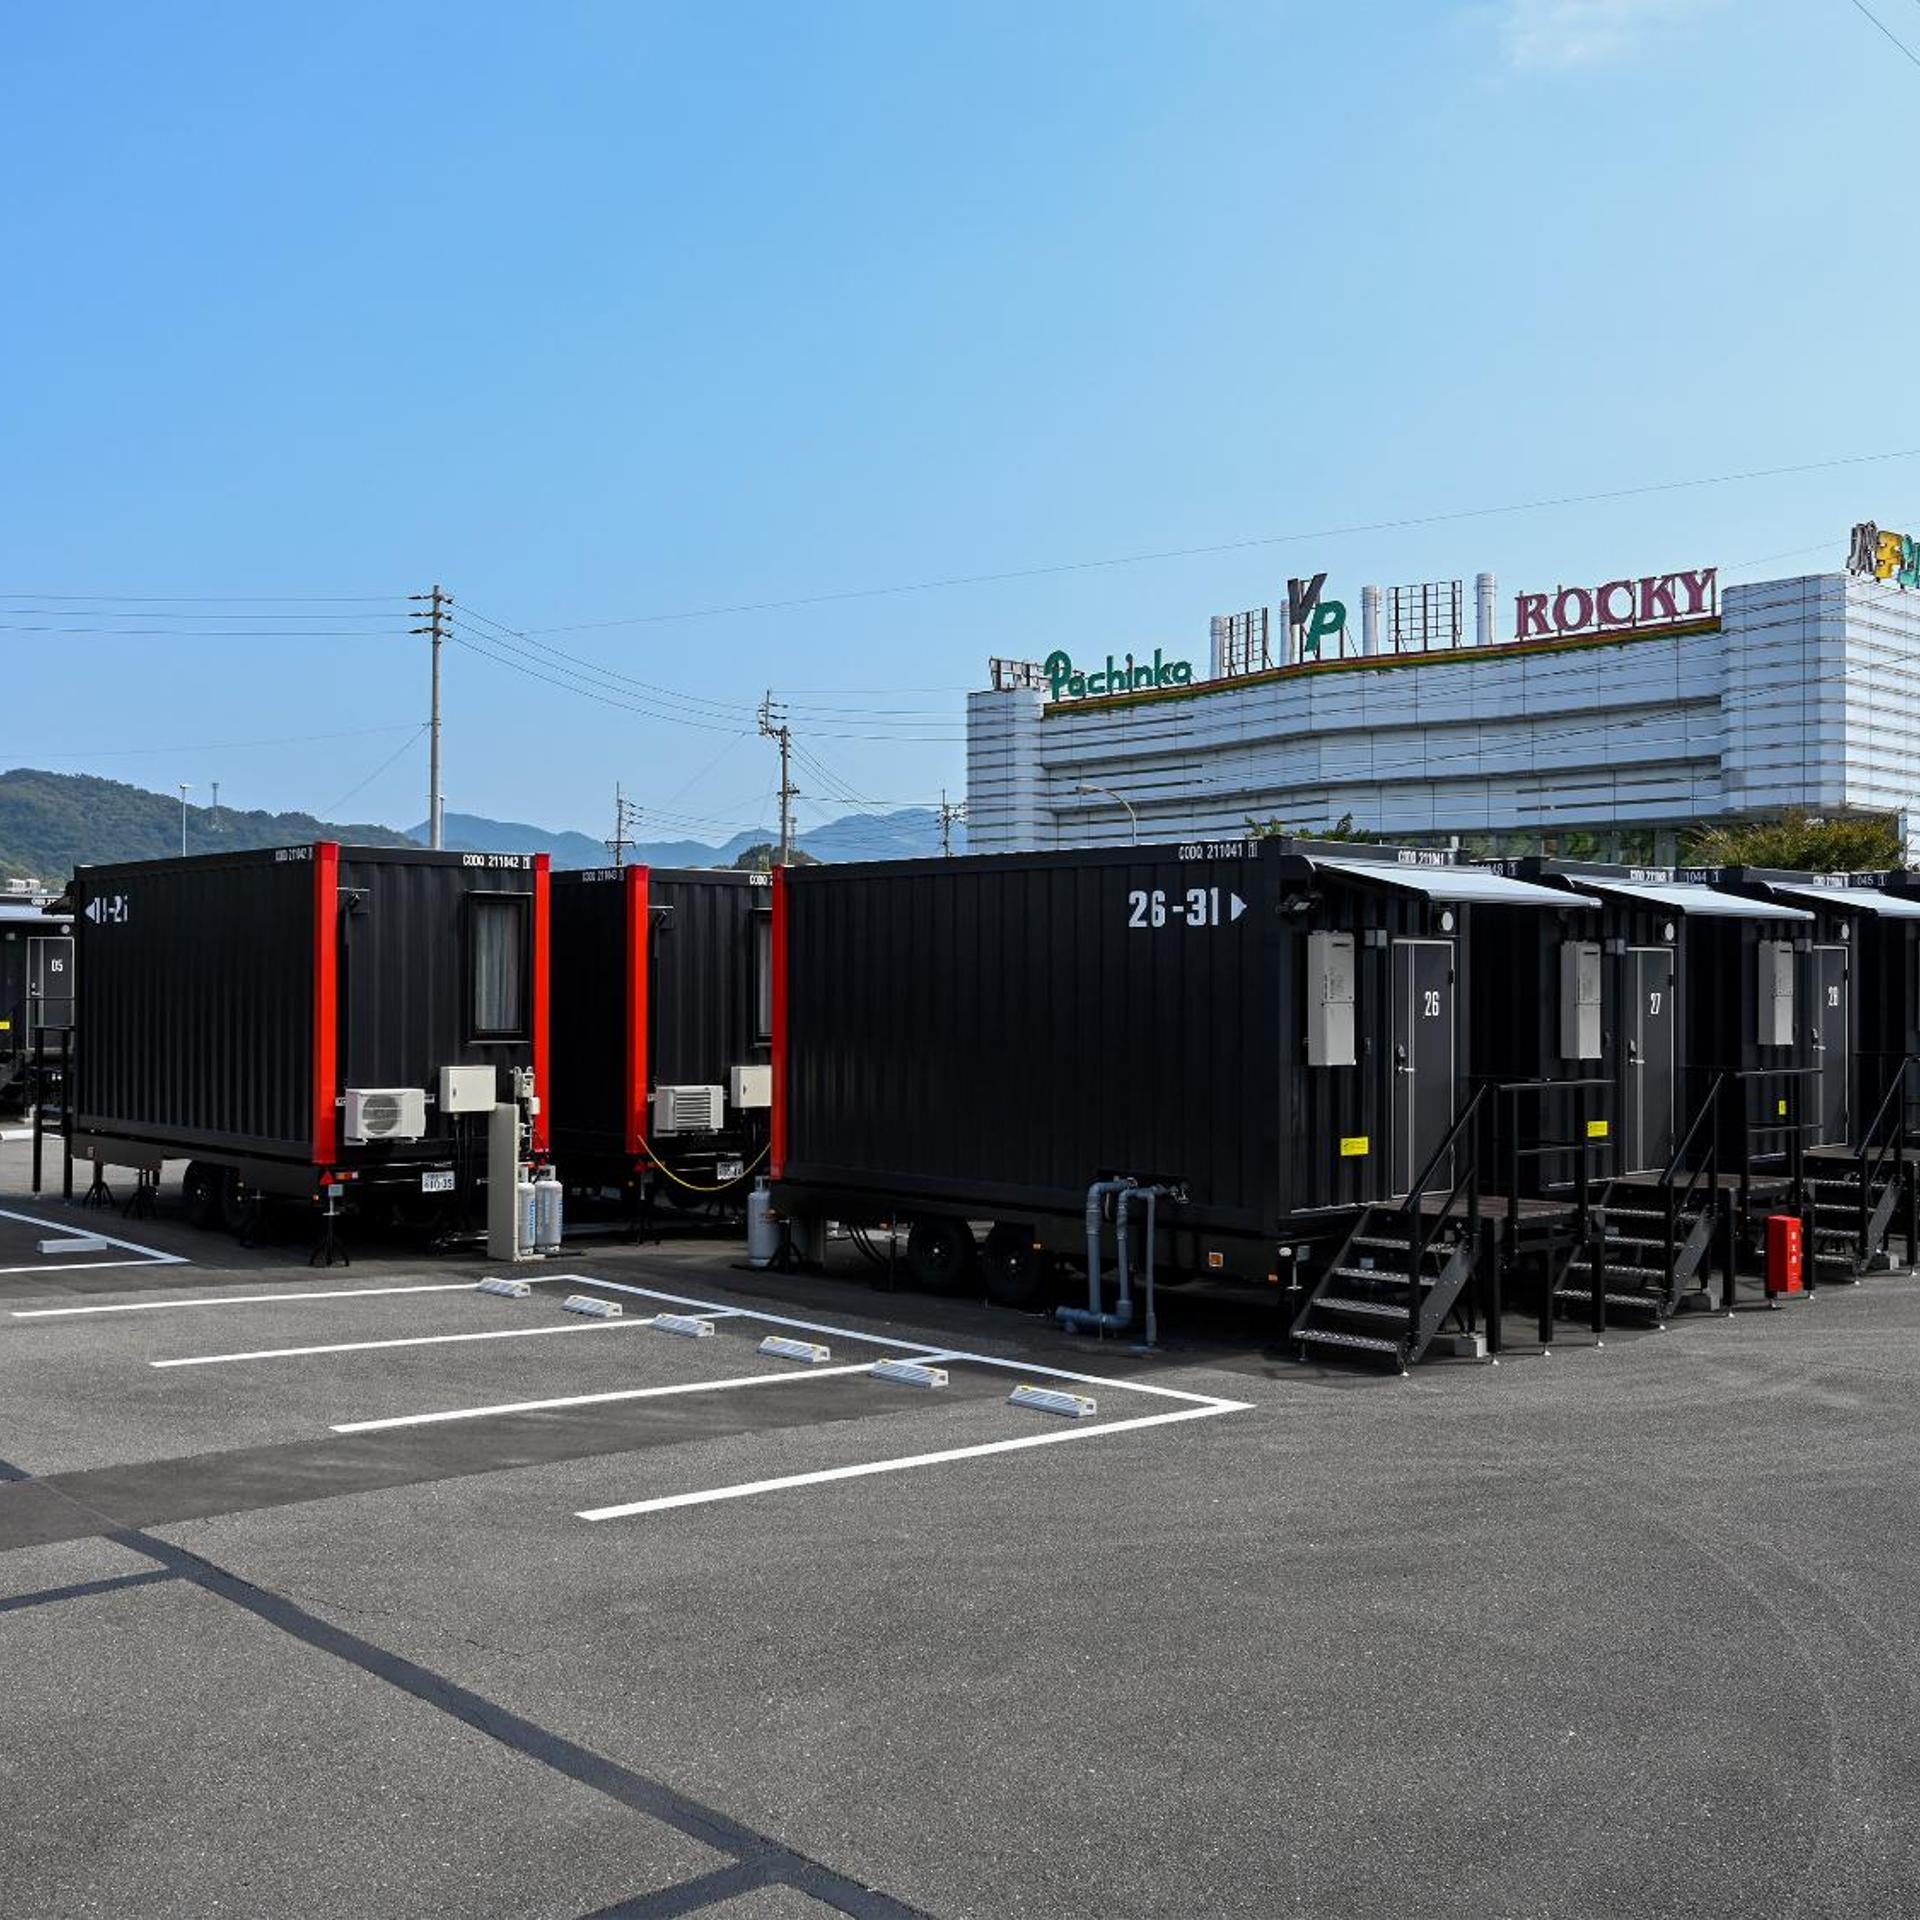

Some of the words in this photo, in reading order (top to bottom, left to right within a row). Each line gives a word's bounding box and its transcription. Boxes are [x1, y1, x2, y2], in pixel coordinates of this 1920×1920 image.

[1515, 567, 1717, 638] ROCKY
[1043, 648, 1192, 701] Pachinko
[1128, 887, 1219, 928] 26-31
[51, 959, 63, 972] 05
[1425, 991, 1440, 1016] 26
[1650, 992, 1661, 1015] 27
